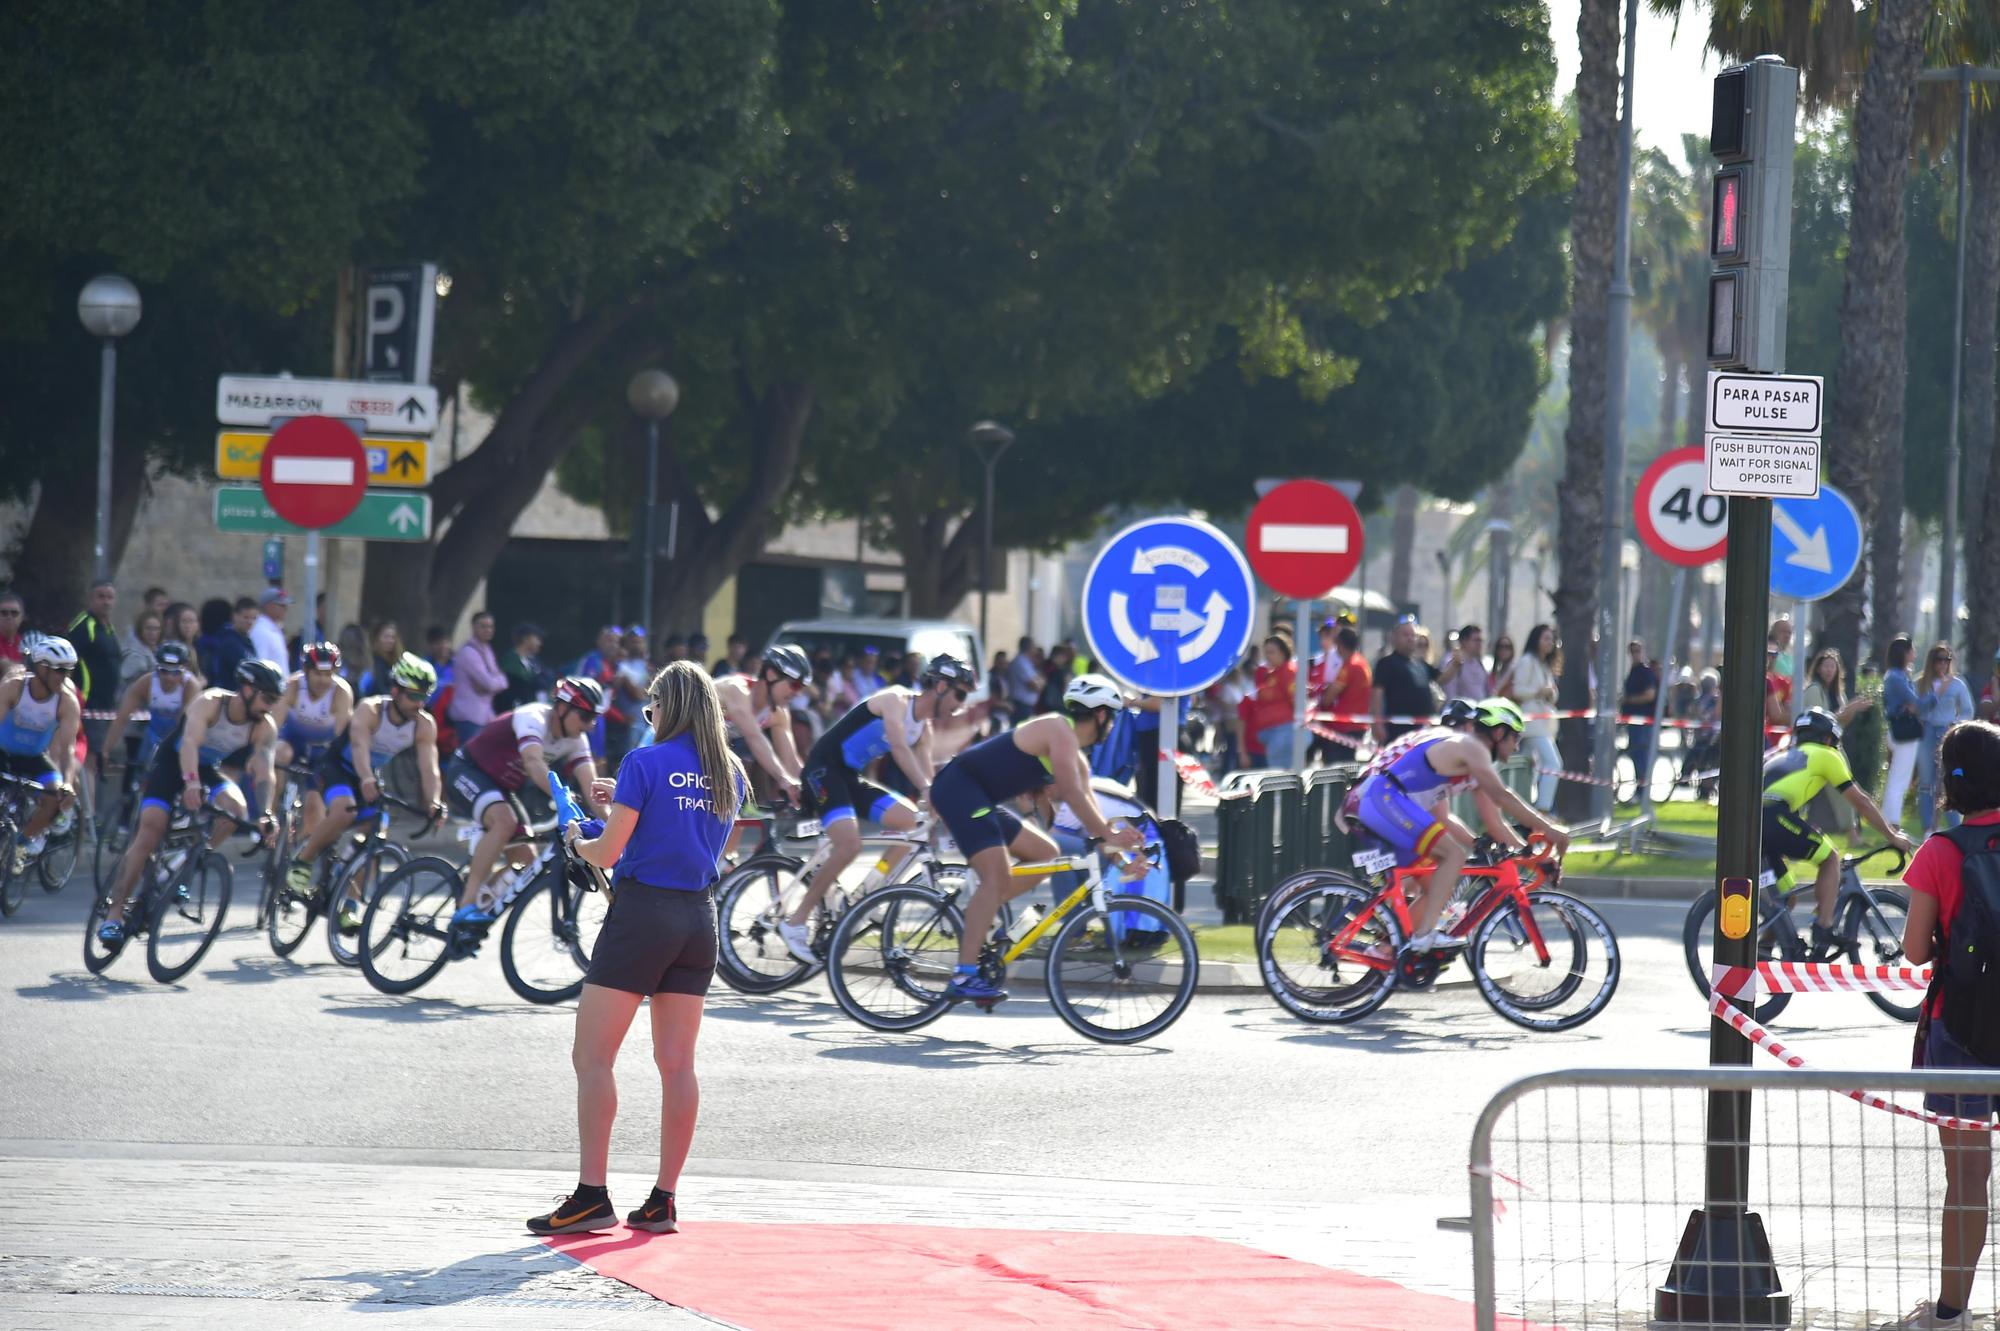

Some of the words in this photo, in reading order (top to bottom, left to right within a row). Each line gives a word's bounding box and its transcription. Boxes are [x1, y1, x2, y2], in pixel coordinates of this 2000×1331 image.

[366, 287, 405, 368] P
[226, 393, 323, 412] MAZARRÓN
[1723, 388, 1760, 401] PARA
[1764, 390, 1810, 403] PASAR
[1744, 406, 1788, 419] PULSE
[1715, 442, 1744, 453] PUSH
[1747, 444, 1790, 455] BUTTON
[1792, 446, 1816, 456] AND
[1719, 457, 1745, 468] WAIT
[1748, 459, 1771, 469] FOR
[1773, 460, 1813, 471] SIGNAL
[1739, 472, 1793, 485] OPPOSITE
[1660, 487, 1728, 525] 40
[669, 772, 713, 790] OFIC
